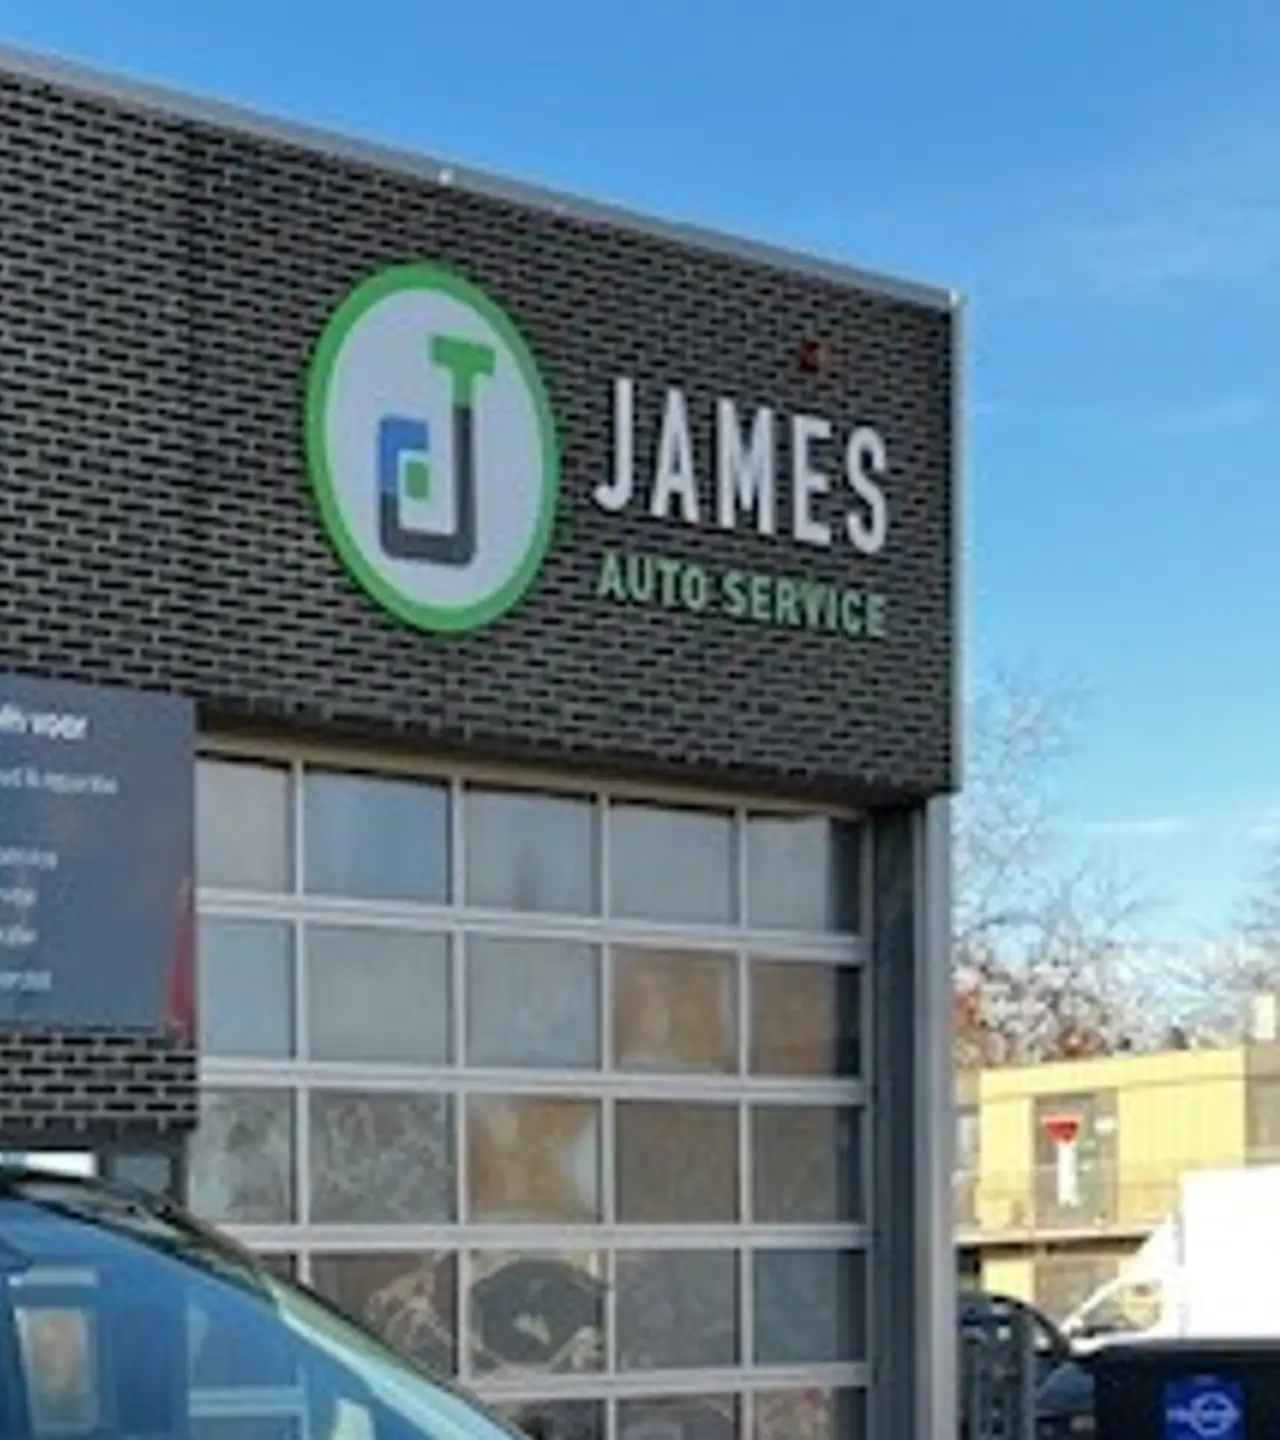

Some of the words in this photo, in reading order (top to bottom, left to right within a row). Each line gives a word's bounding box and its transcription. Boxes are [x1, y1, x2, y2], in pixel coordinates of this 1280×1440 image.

[593, 377, 887, 552] JAMES
[597, 552, 707, 611] AUTO
[722, 571, 887, 637] SERVICE
